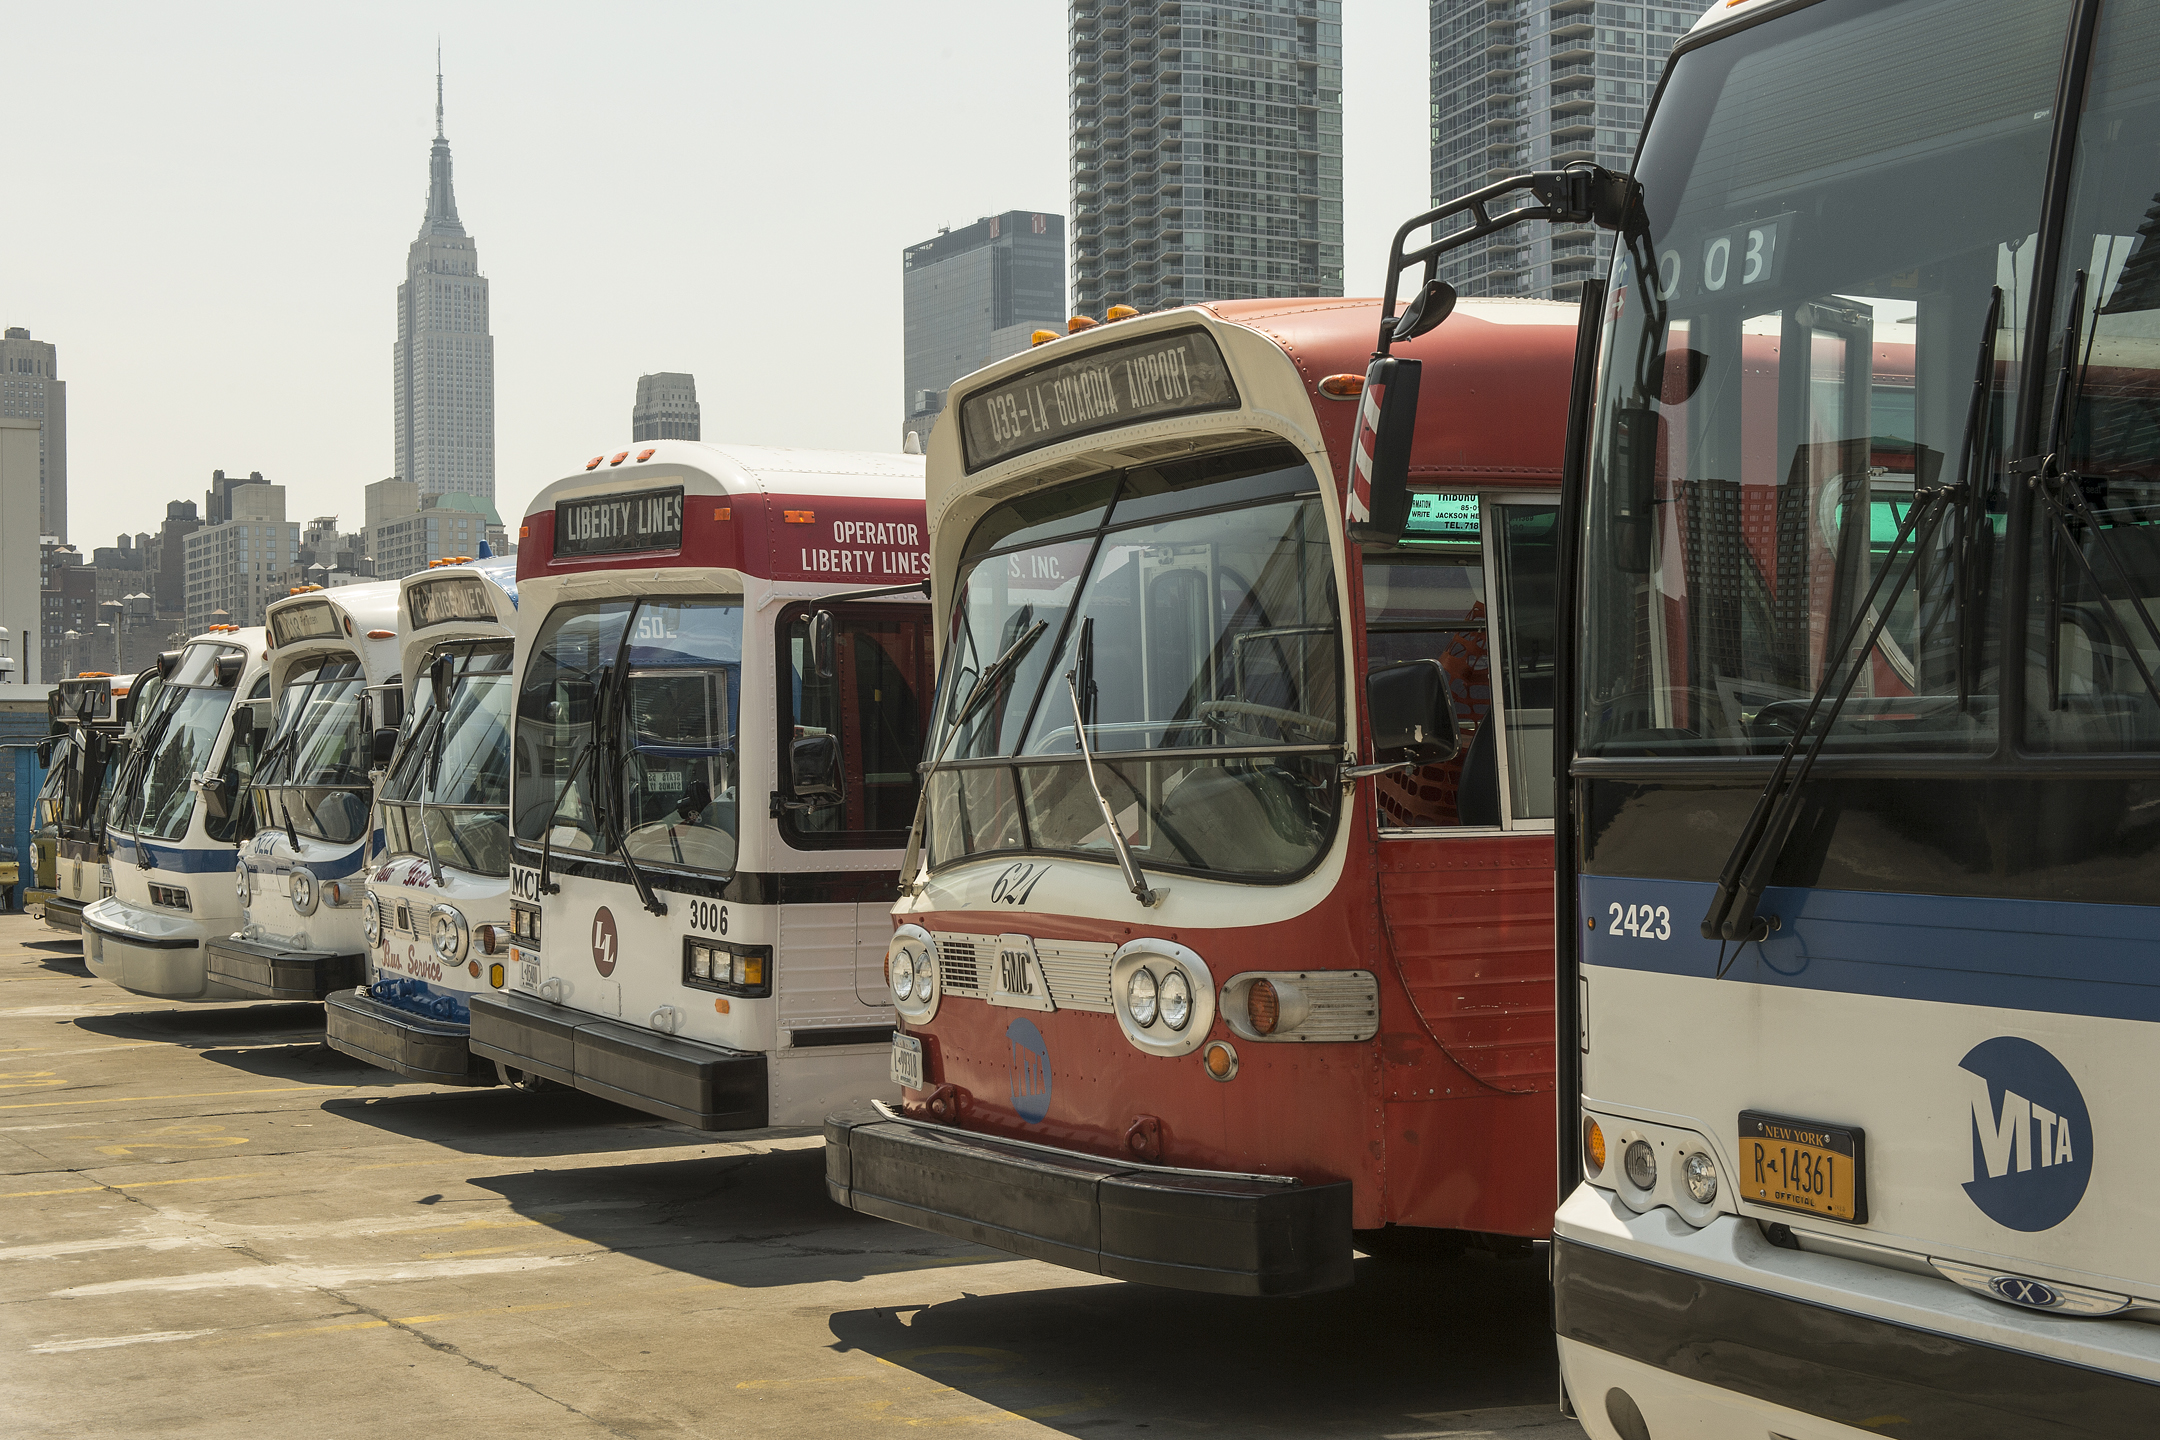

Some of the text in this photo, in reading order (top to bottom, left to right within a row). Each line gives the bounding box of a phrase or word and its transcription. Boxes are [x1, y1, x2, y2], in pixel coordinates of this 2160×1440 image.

[1053, 366, 1119, 427] GUARDIA
[1125, 346, 1192, 409] AIRPORT
[567, 494, 682, 541] LIBERTY LINES
[833, 520, 919, 546] OPERATOR
[1464, 522, 1479, 530] 718
[801, 548, 931, 575] LIBERTY LINES
[1031, 554, 1065, 580] INC.
[511, 866, 541, 902] MCI
[990, 862, 1053, 906] 621
[689, 899, 729, 936] 3006
[1608, 901, 1672, 941] 2423
[407, 943, 443, 982] Service
[999, 950, 1033, 995] GMC
[1765, 1125, 1825, 1147] NEW YORK
[1774, 1190, 1816, 1208] OFFICIAL
